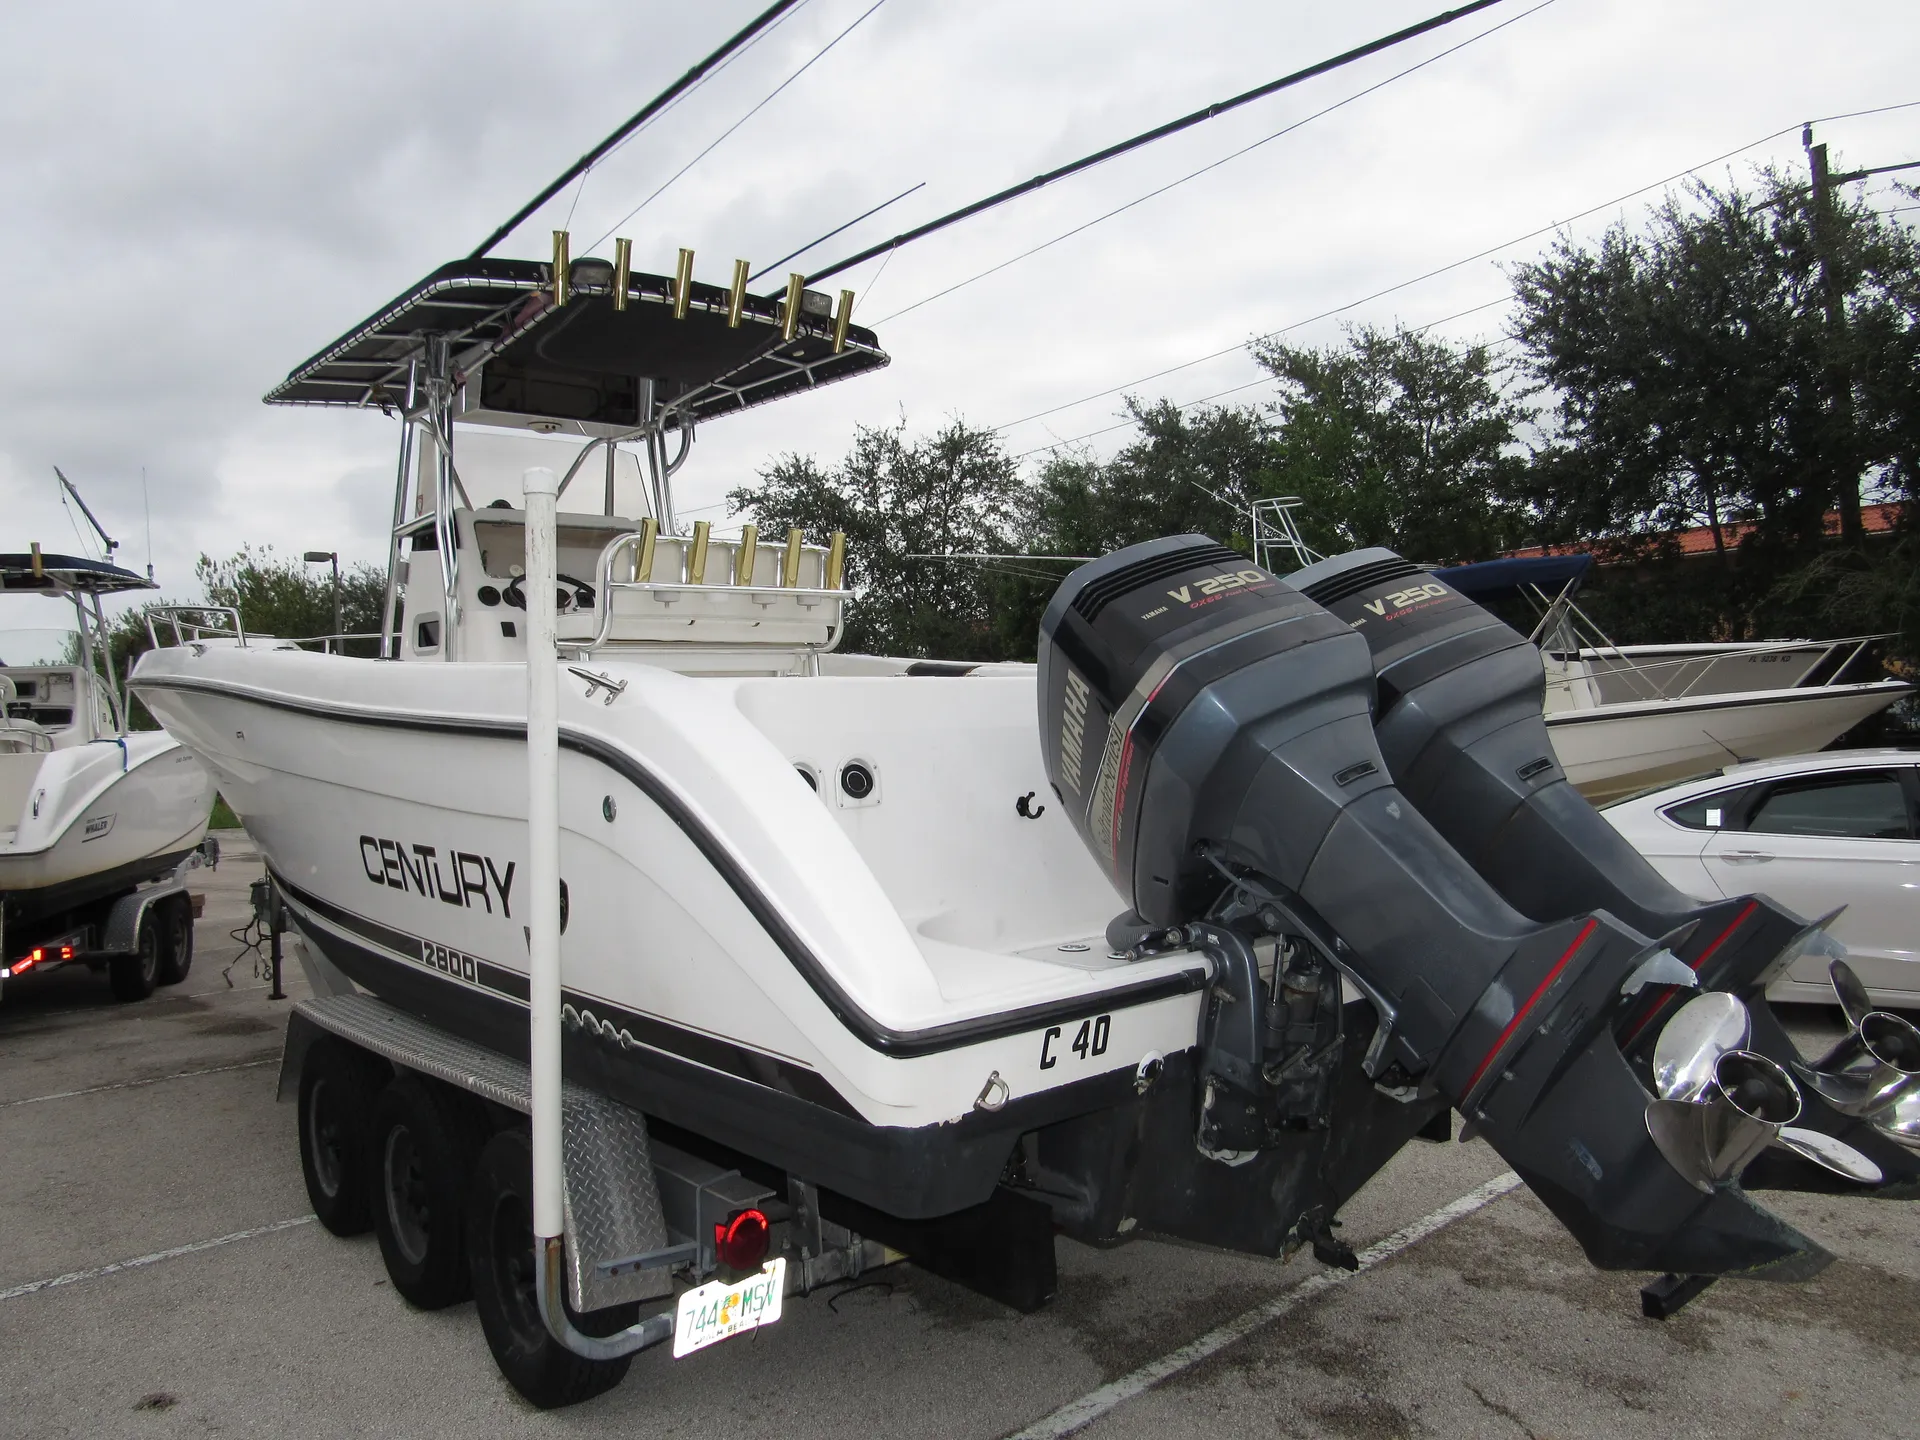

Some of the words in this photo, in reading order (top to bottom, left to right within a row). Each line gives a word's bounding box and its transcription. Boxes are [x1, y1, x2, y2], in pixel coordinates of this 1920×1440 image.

[1167, 585, 1192, 604] V
[1193, 570, 1266, 595] 250
[1363, 598, 1386, 616] V
[1385, 583, 1447, 608] 250
[1141, 606, 1168, 620] YAMAHA
[1062, 669, 1090, 797] YAMAHA
[359, 835, 516, 919] CENTURY
[424, 942, 475, 983] 2800
[1040, 1026, 1060, 1070] C
[1072, 1015, 1111, 1060] 40
[686, 1299, 719, 1339] 744
